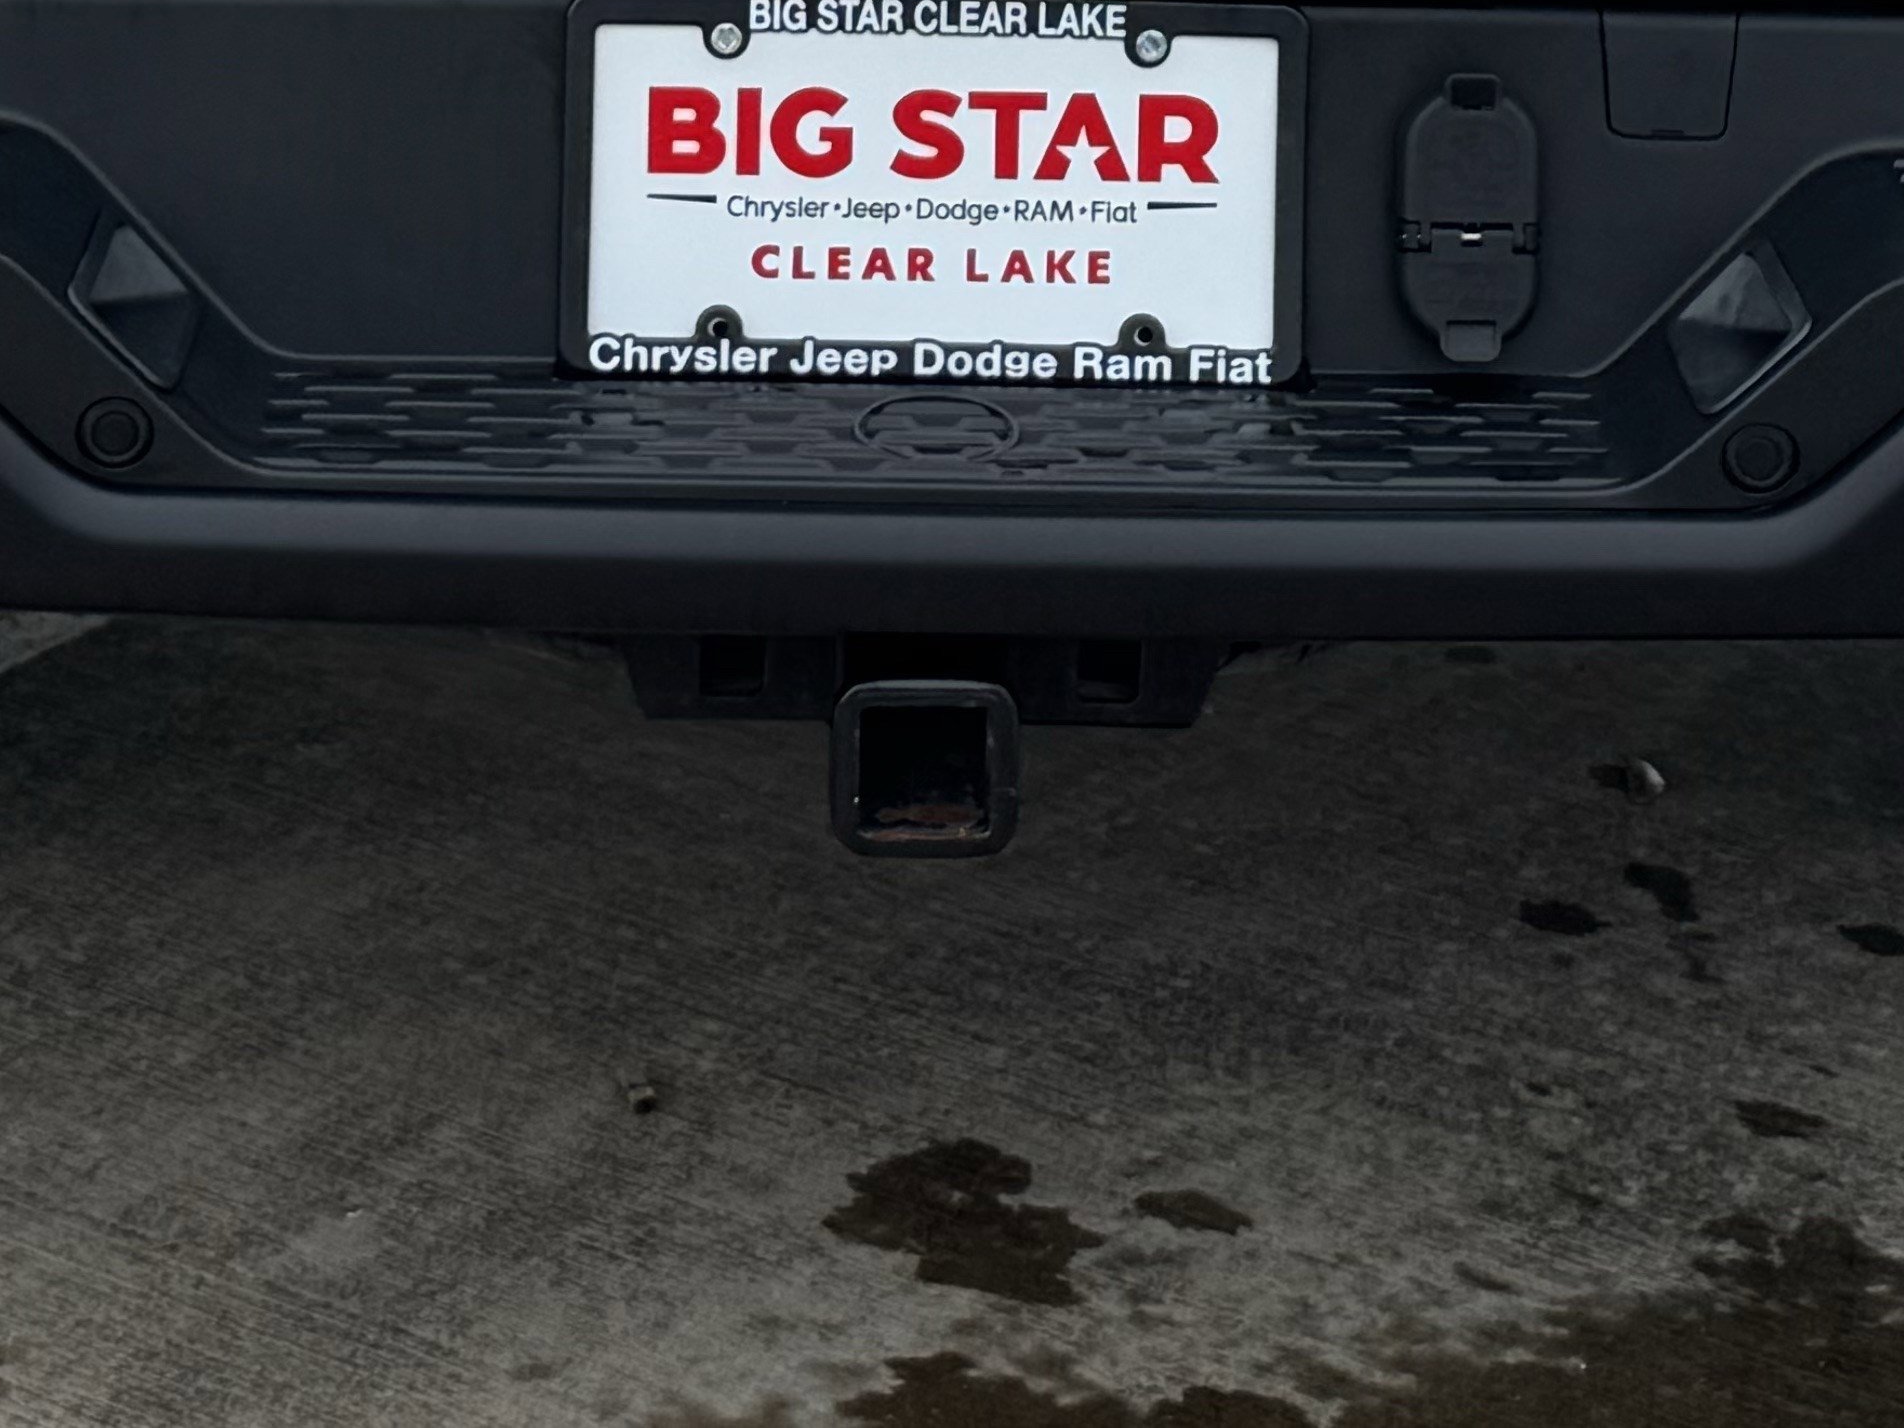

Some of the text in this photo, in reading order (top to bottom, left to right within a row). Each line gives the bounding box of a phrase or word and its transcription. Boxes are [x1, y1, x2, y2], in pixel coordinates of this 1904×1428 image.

[914, 0, 1028, 36] CLEAR
[1038, 2, 1127, 38] LAKE
[647, 86, 1220, 184] BIG STAR
[751, 245, 1112, 284] CLEAR LAKE
[589, 338, 1273, 384] Chrysler Jeep Dodge Ram Fiat
